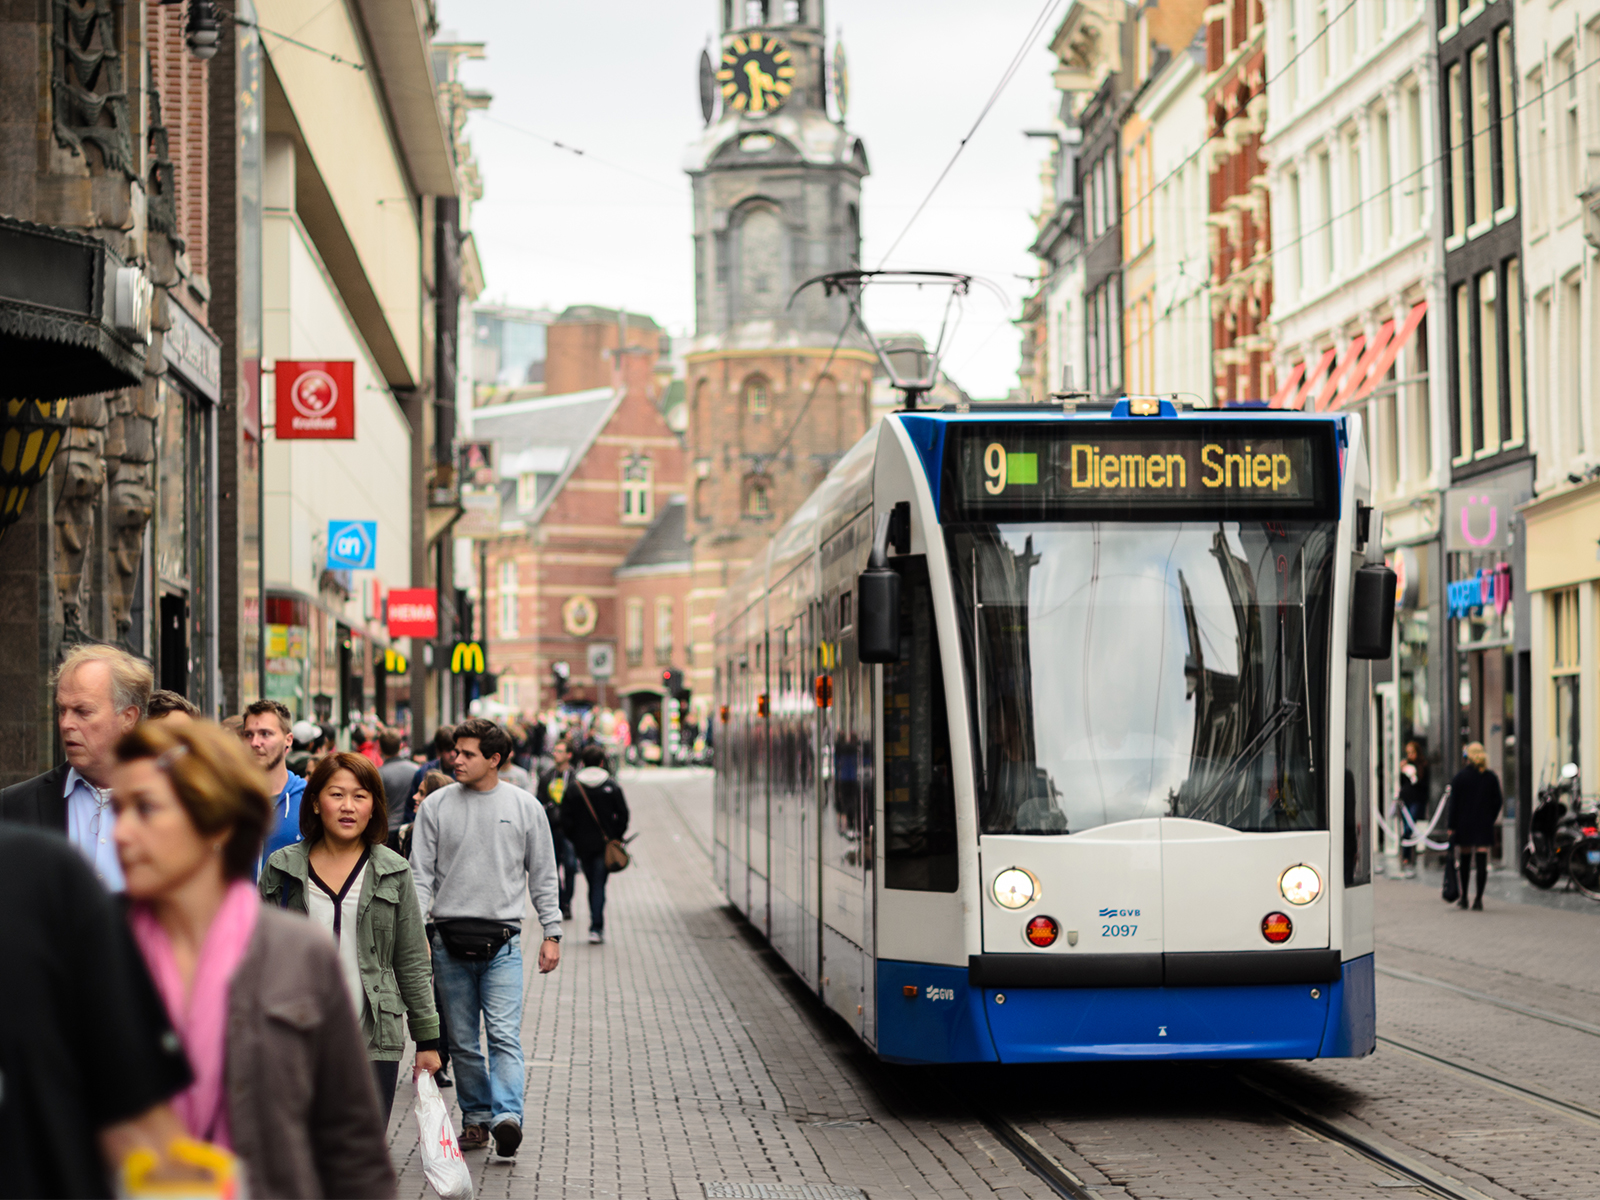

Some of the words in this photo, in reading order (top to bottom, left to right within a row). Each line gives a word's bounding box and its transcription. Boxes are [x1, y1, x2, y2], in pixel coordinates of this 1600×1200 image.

[983, 442, 1008, 495] 9
[1070, 443, 1187, 489] Diemen
[1201, 443, 1292, 491] Sniep
[387, 603, 437, 622] HEMA
[1119, 908, 1141, 917] GVB
[1101, 924, 1139, 938] 2097
[939, 987, 955, 1001] GVB
